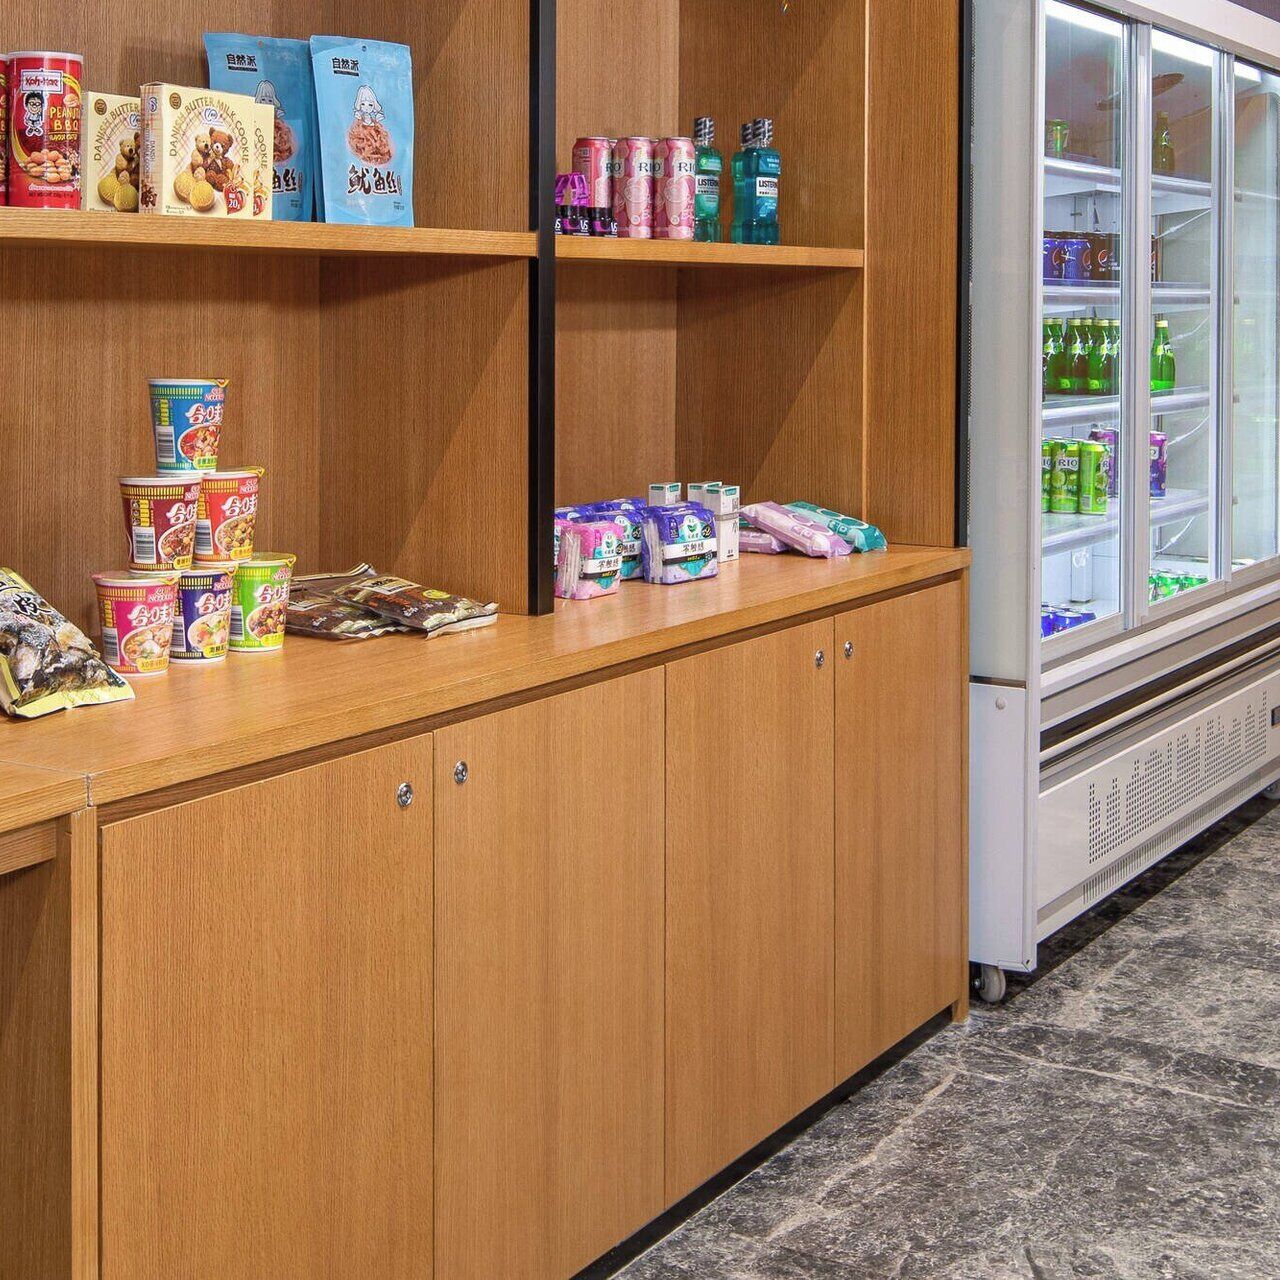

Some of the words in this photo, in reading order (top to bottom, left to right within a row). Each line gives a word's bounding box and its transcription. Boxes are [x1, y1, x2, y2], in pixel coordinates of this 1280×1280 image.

[226, 53, 257, 67] 自然派
[332, 57, 359, 71] 自然派
[216, 99, 236, 123] MILK
[235, 120, 249, 165] COOKIE
[255, 127, 268, 170] COOKIE
[1058, 459, 1079, 468] RIO
